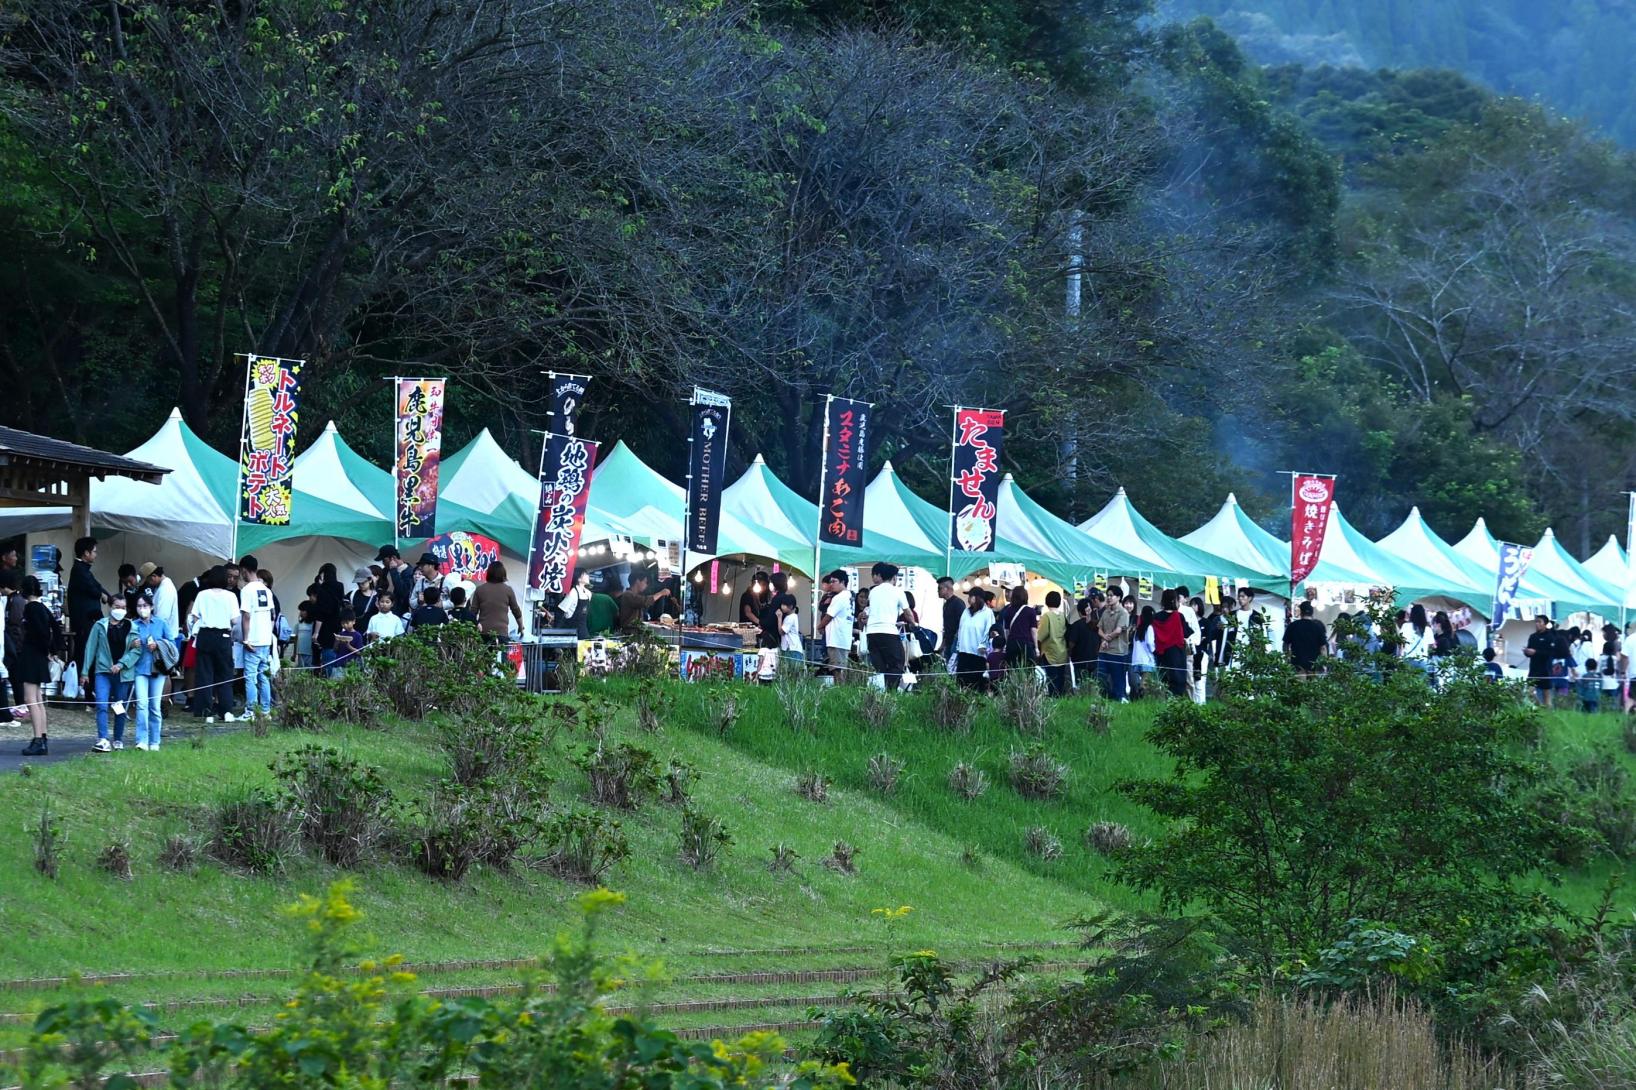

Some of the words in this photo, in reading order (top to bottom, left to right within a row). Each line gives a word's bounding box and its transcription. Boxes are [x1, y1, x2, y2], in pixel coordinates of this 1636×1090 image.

[271, 368, 296, 479] トルネード
[399, 386, 427, 537] 鹿児島黒牛
[247, 450, 271, 518] ポテト
[700, 441, 712, 502] MOTHER
[828, 409, 854, 538] スタミナあご肉
[956, 416, 998, 520] たません
[698, 507, 707, 543] BEEF
[1299, 503, 1319, 565] 焼きそば
